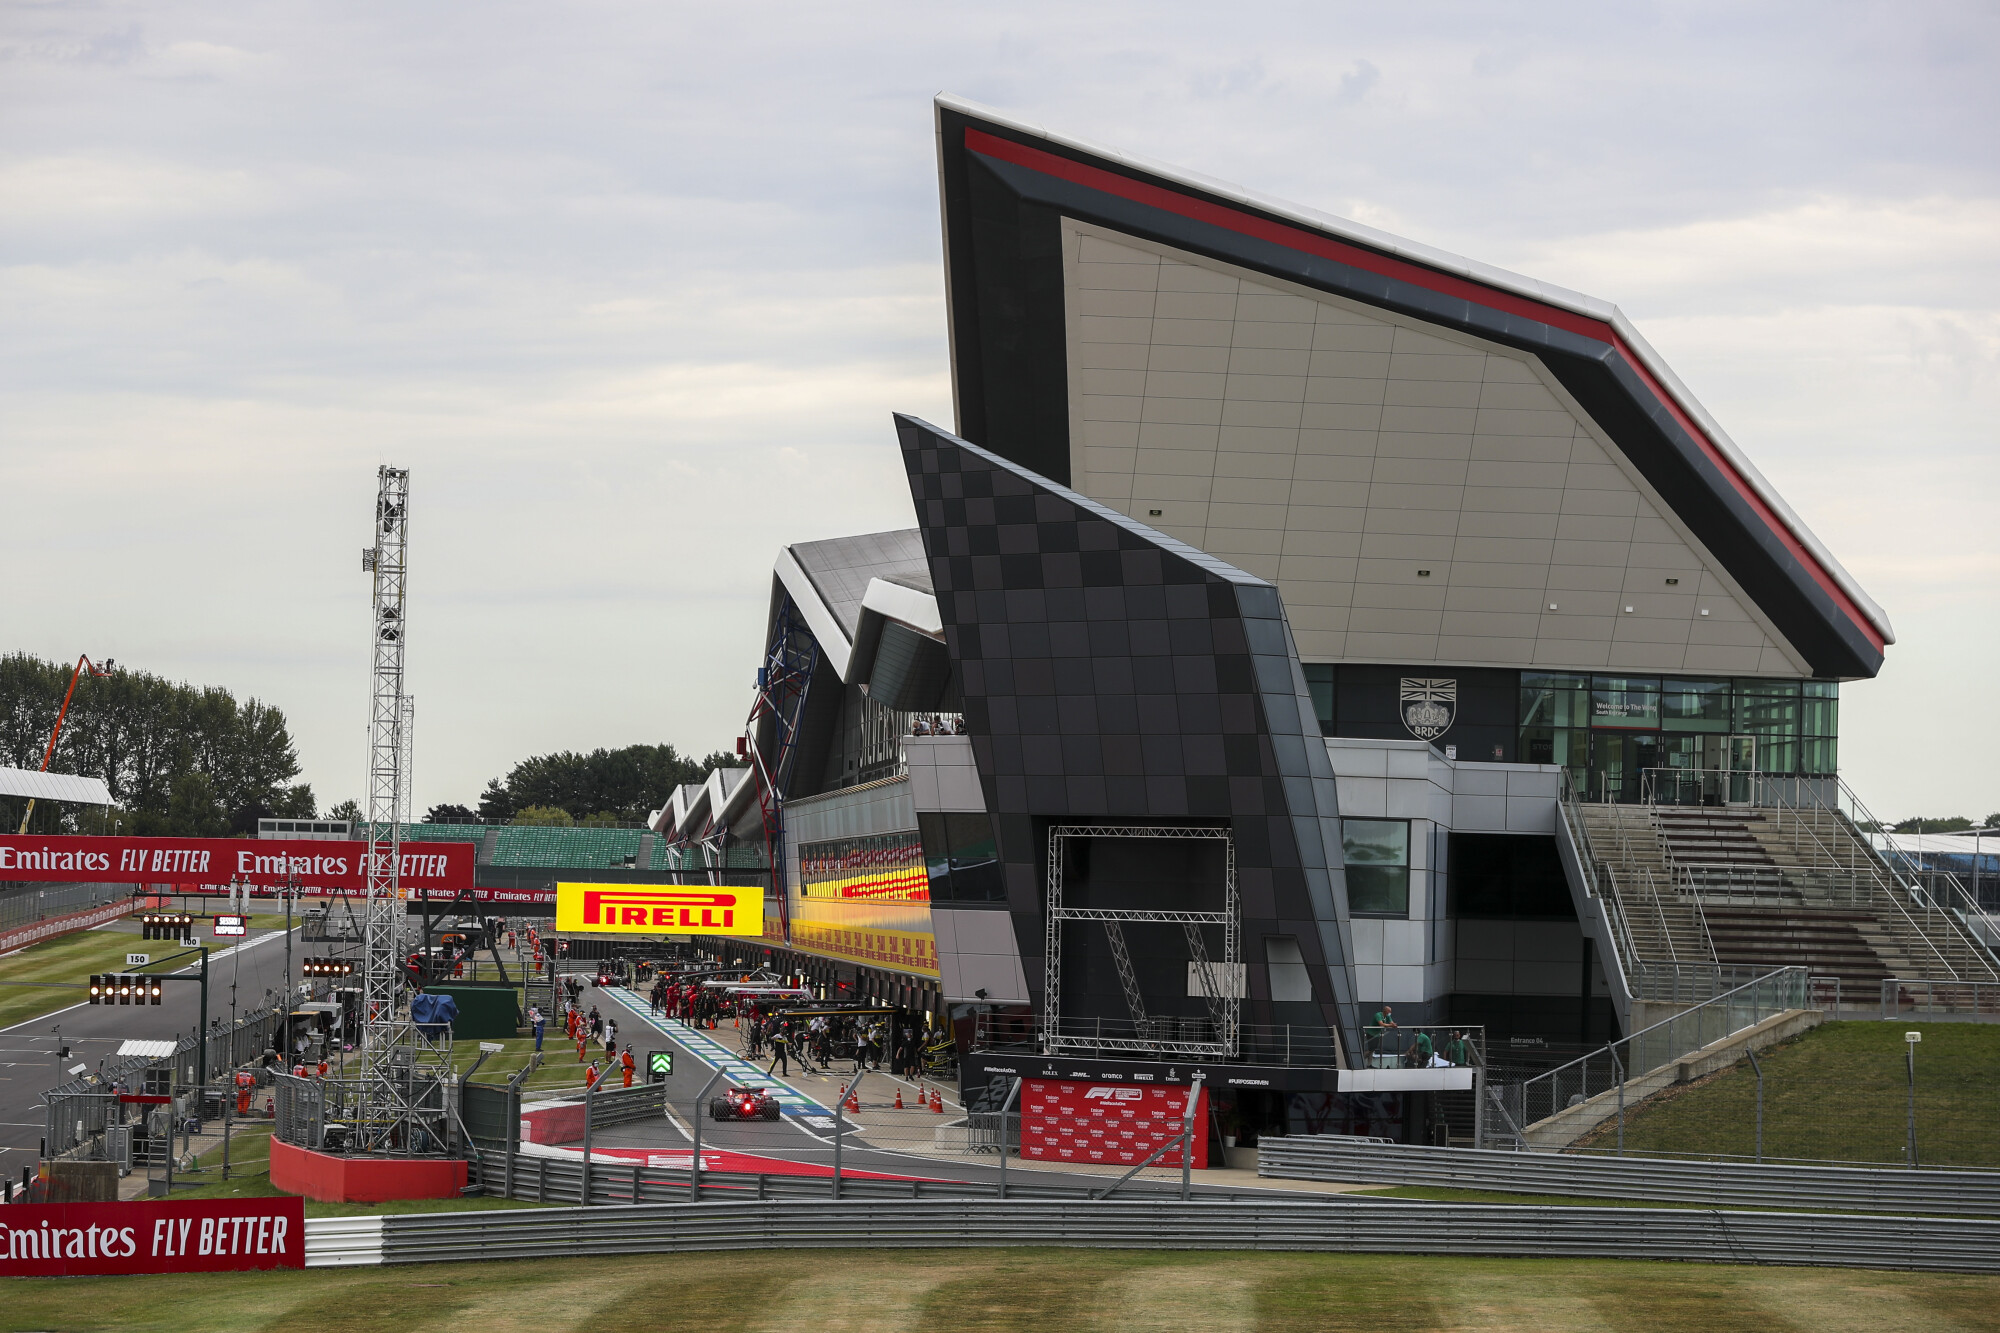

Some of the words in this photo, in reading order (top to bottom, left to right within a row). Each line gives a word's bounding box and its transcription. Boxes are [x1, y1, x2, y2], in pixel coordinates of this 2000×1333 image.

[1415, 726, 1439, 737] BRDC
[0, 846, 110, 870] Emirates
[120, 849, 148, 871] FLY
[152, 850, 210, 872] BETTER
[237, 851, 348, 875] Emirates
[358, 853, 386, 875] FY
[388, 854, 447, 877] ETTER
[494, 891, 531, 901] Emirates
[533, 893, 544, 901] FLY
[584, 891, 736, 927] PIRELLI
[152, 1219, 192, 1256] FLY
[199, 1216, 287, 1256] BETTER
